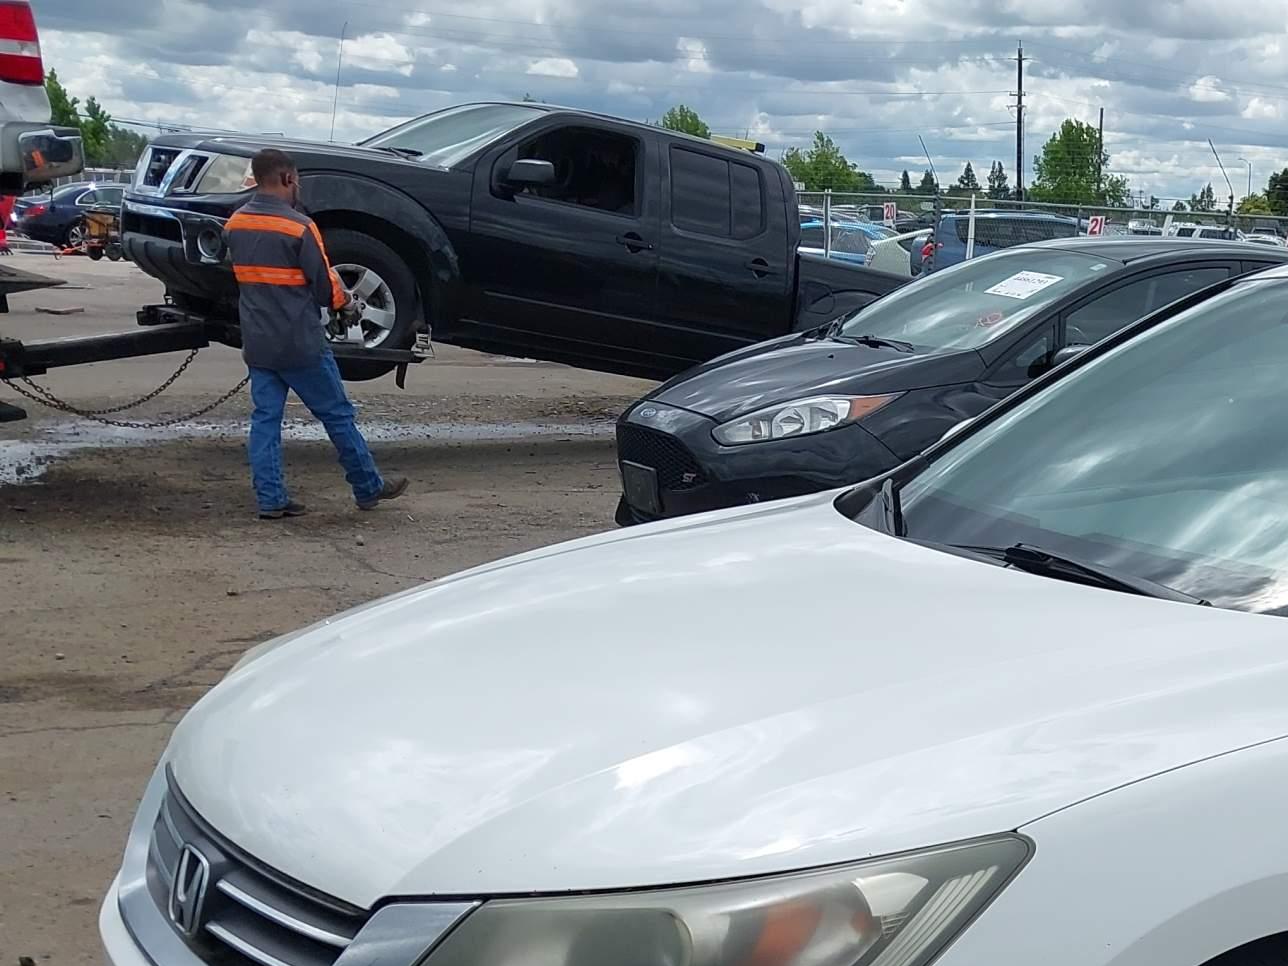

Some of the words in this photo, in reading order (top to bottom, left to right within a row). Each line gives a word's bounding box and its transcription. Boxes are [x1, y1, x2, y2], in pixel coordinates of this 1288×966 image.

[885, 204, 895, 220] 20
[1089, 217, 1104, 235] 21
[682, 472, 697, 483] ST
